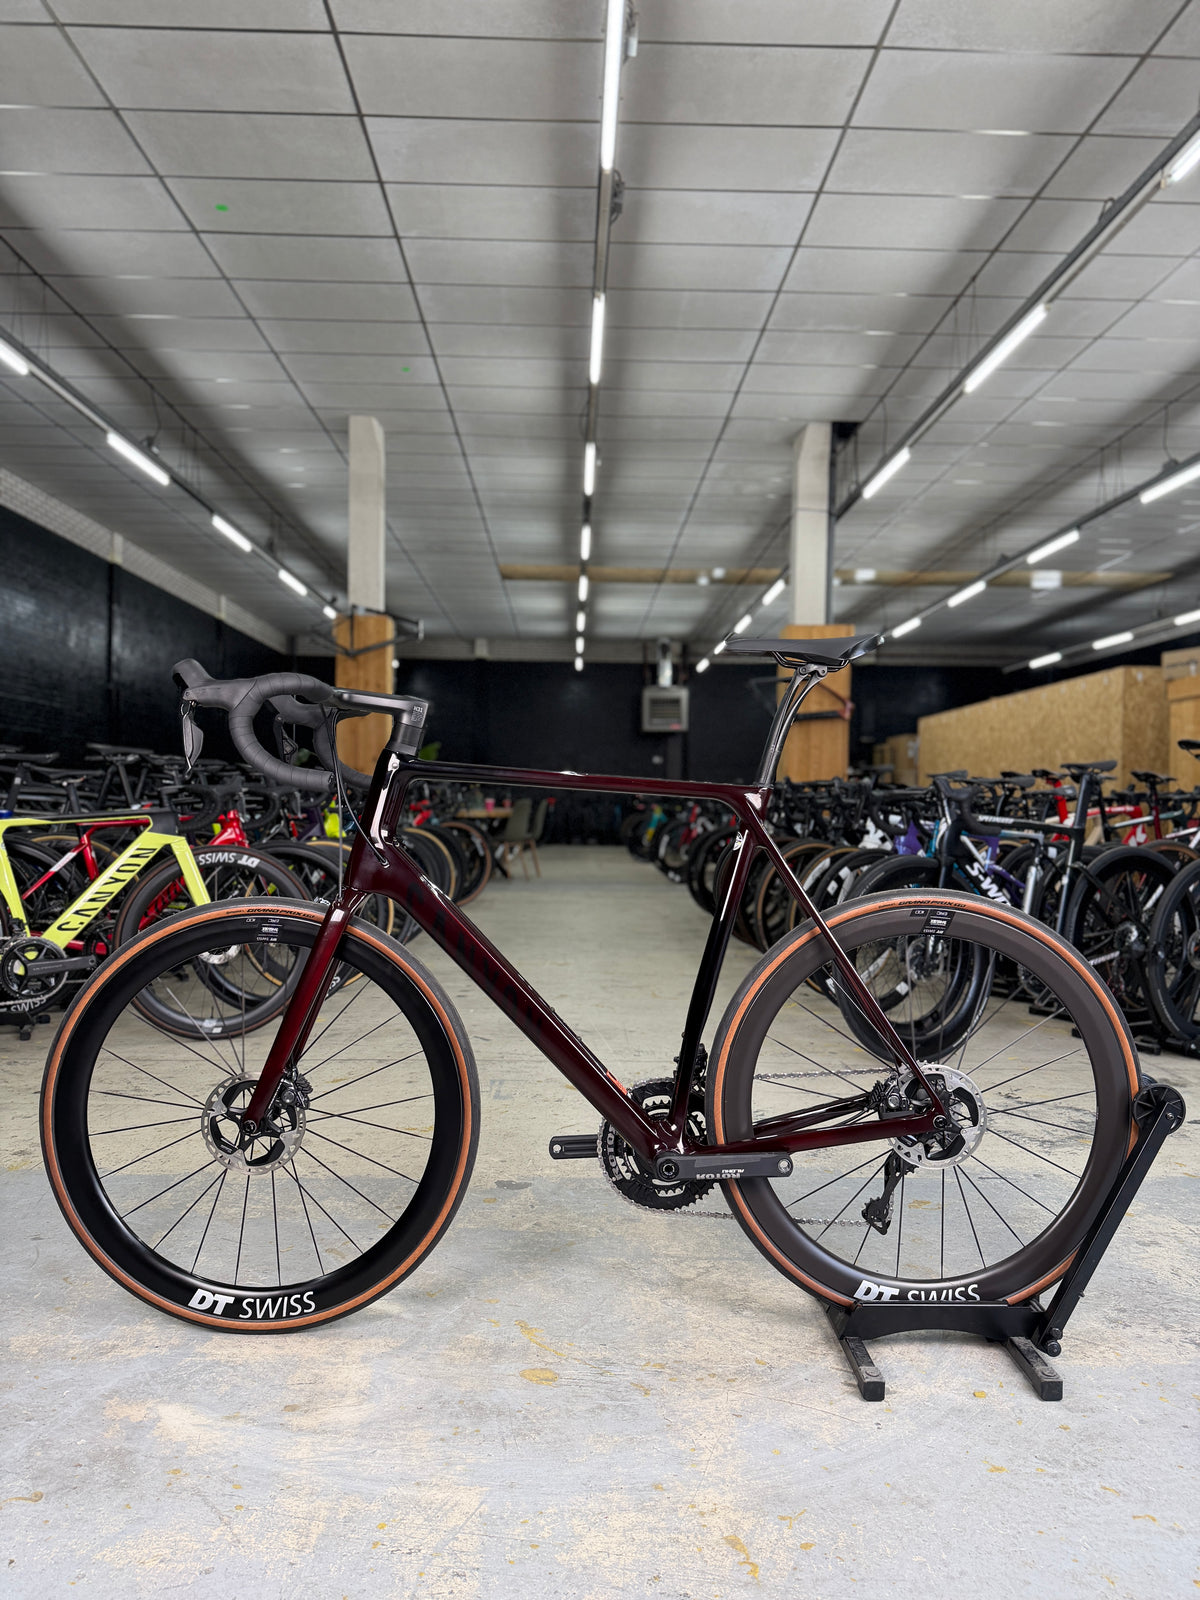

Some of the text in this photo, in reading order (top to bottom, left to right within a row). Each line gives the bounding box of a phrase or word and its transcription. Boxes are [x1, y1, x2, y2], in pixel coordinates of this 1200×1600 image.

[199, 852, 260, 868] DT SWISS
[56, 848, 158, 931] CANYON
[280, 909, 302, 917] PRIX
[853, 1280, 980, 1300] DT SWISS
[188, 1288, 316, 1319] DT SWISS
